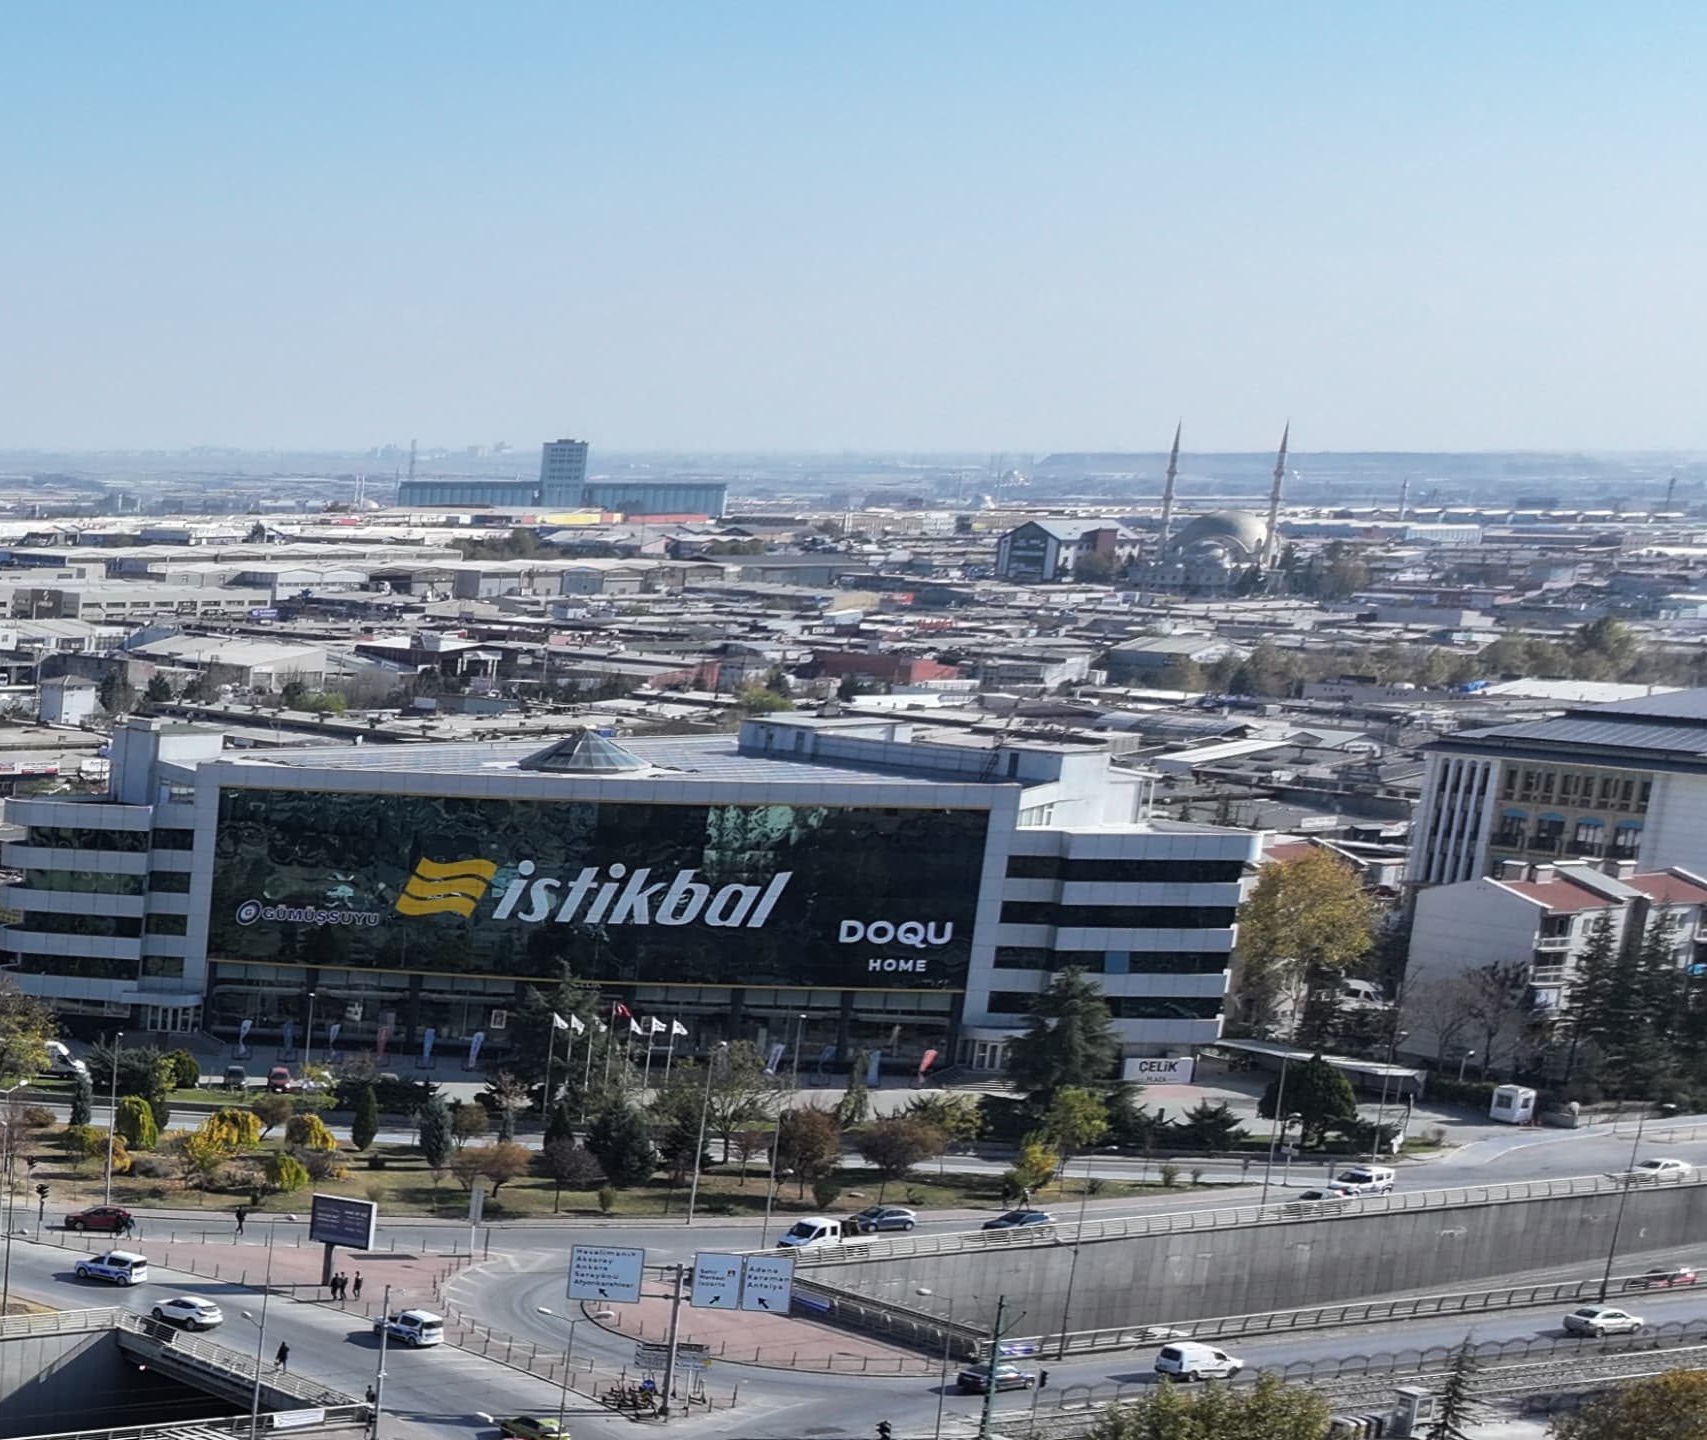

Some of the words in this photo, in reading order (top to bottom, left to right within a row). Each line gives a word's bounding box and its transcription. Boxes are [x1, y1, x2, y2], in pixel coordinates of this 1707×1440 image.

[492, 860, 792, 928] istikbal
[261, 906, 380, 928] GÜMÜŞSUYU
[837, 919, 953, 948] DOQU
[868, 959, 927, 972] HOME
[1138, 1060, 1180, 1075] ÇELİK
[749, 1266, 778, 1274] Adana
[747, 1282, 783, 1290] Antalya
[748, 1275, 790, 1283] Karaman
